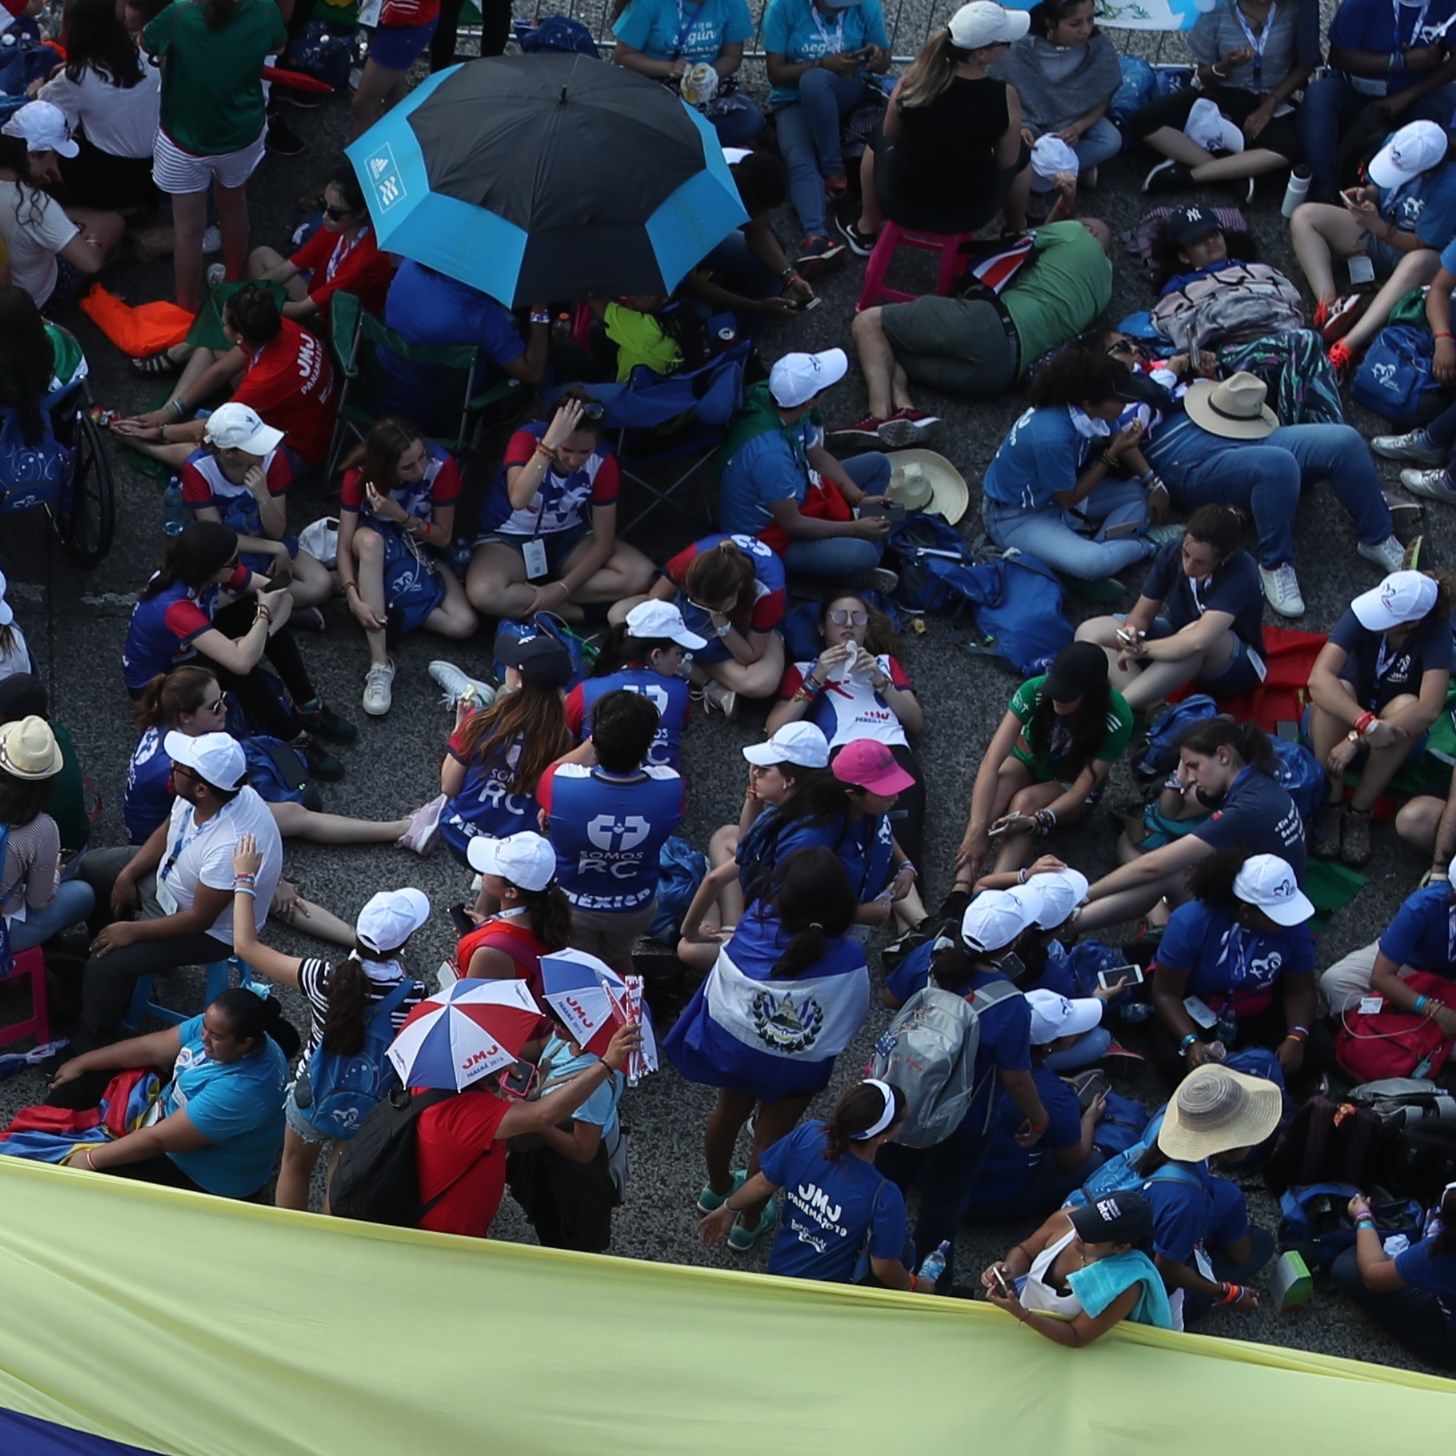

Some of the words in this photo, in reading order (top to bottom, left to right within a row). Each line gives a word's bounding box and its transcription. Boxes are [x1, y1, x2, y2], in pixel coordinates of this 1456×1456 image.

[297, 332, 315, 377] JMJ
[579, 850, 644, 860] SOMOS
[577, 859, 640, 879] RC
[565, 996, 595, 1029] JMJ
[462, 1045, 499, 1070] JMJ
